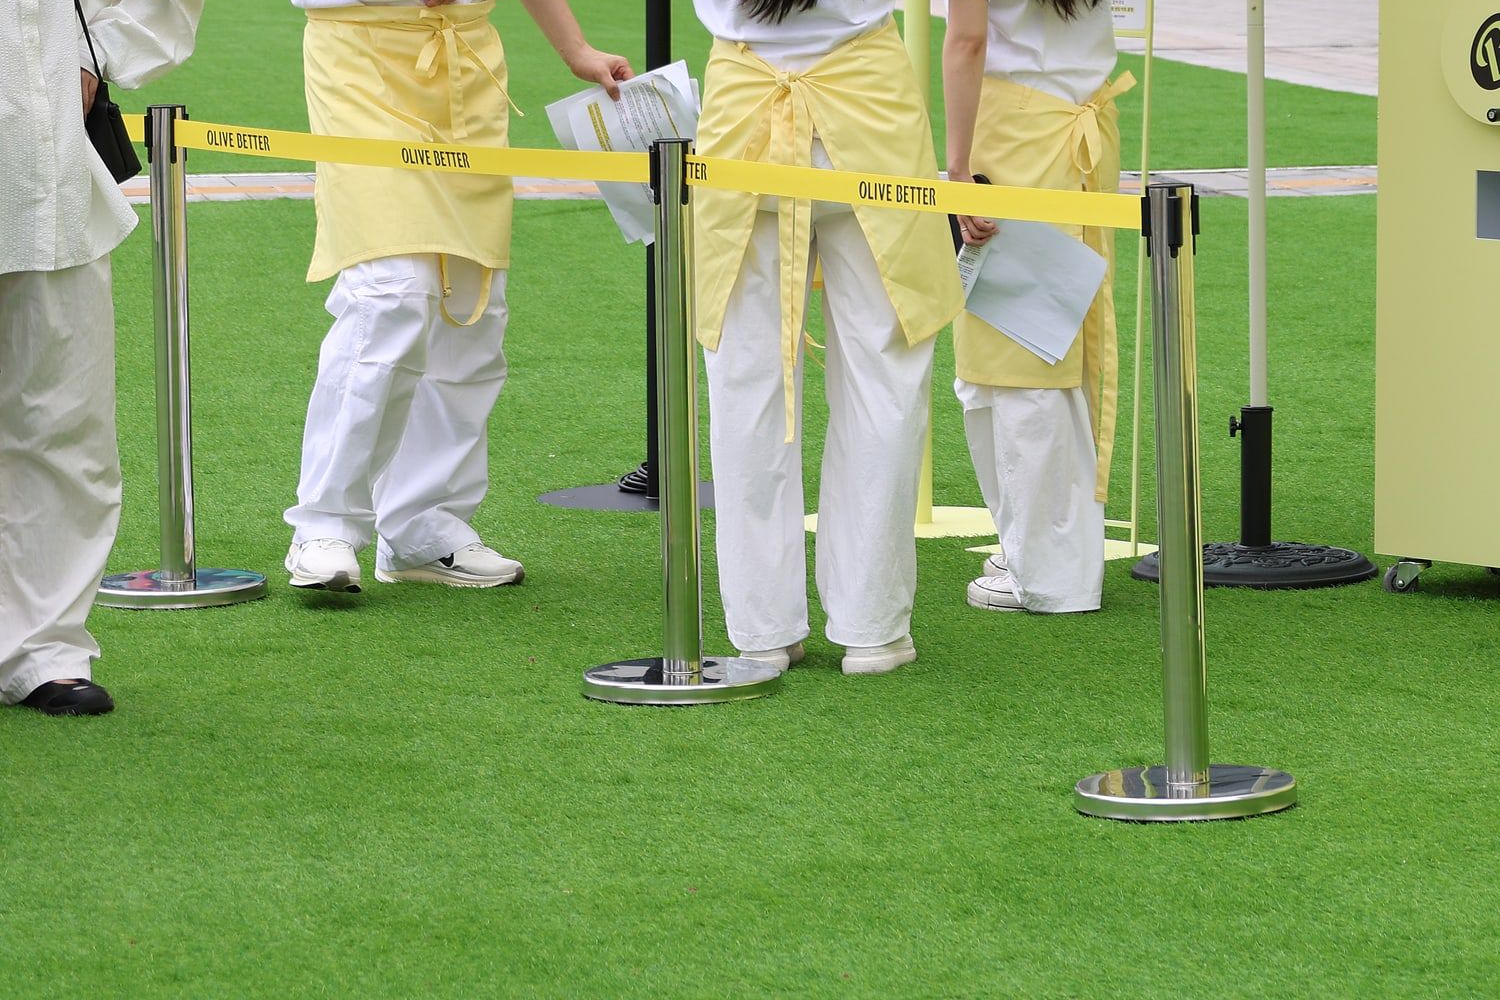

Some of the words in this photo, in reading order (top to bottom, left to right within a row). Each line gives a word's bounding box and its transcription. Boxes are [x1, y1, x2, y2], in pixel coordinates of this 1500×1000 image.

[207, 129, 235, 148] OLIVE
[236, 133, 271, 151] BETTER
[401, 147, 432, 166] OLIVE
[433, 150, 471, 169] BETTER
[859, 181, 892, 202] OLIVE
[896, 184, 936, 206] BETTER
